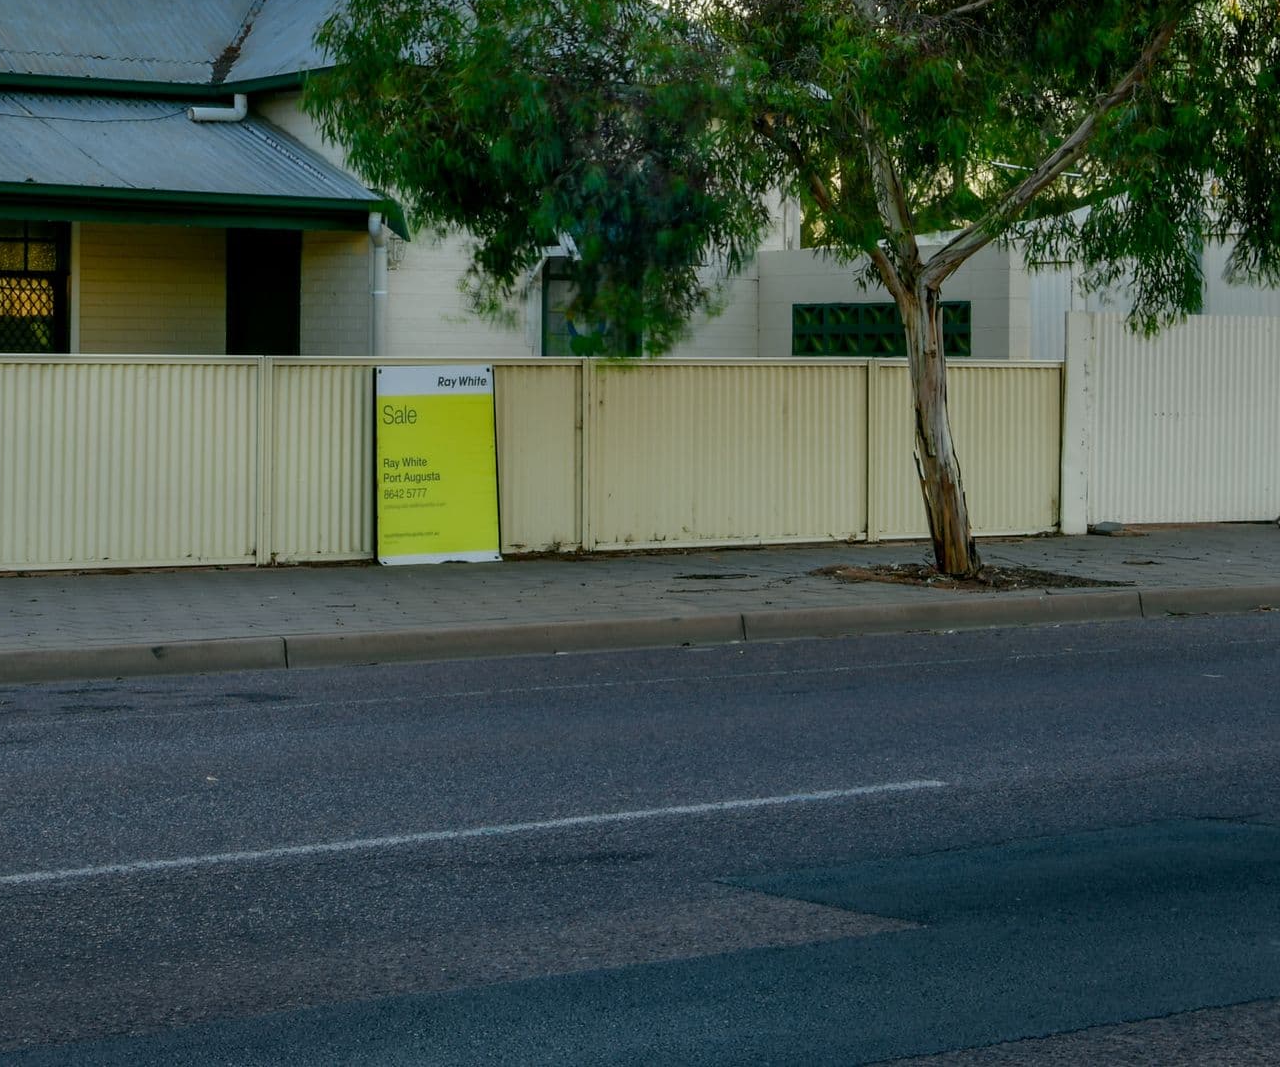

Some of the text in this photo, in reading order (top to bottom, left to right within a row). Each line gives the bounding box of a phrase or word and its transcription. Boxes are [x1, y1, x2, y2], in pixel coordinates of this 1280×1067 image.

[437, 376, 487, 388] Ray White
[383, 404, 417, 425] Sale
[383, 457, 428, 469] Ray White
[383, 472, 441, 484] Port Augusta
[383, 487, 428, 500] 8642 5777
